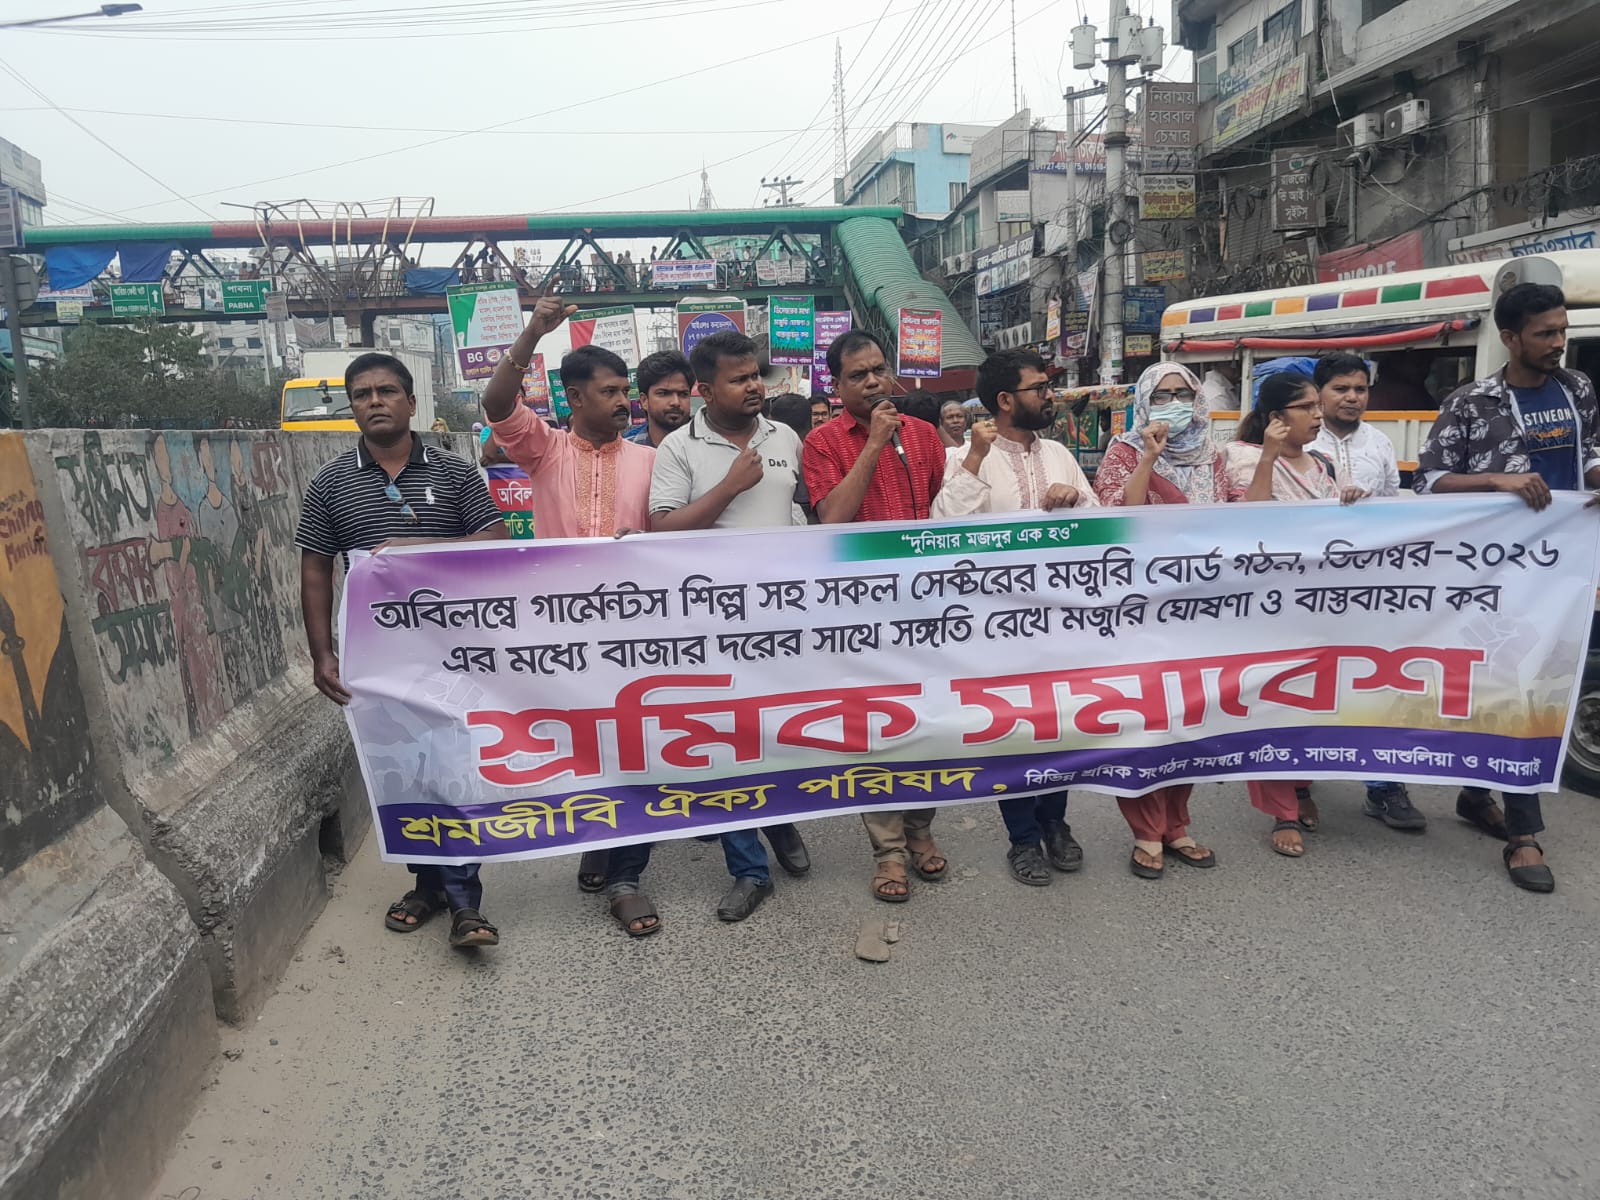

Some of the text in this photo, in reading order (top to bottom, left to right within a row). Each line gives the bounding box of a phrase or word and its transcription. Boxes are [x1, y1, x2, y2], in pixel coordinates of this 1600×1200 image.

[1150, 86, 1195, 104] নিরাময়
[1149, 111, 1195, 124] হারবাল
[226, 285, 252, 294] পাবনা
[228, 301, 254, 309] PABNA
[466, 352, 484, 363] BG
[901, 523, 1079, 554] “দুনিয়ার মজদুর এক হও”
[371, 588, 518, 630] অবিলম্বে
[531, 582, 668, 623] গার্মেন্টস
[679, 574, 747, 621] শিল্প
[757, 578, 806, 612] সহ
[815, 573, 900, 606] সকল
[910, 560, 1037, 596] সেক্টরের
[1045, 547, 1135, 597] মজুরি
[1146, 546, 1223, 591] বোর্ড
[442, 585, 1502, 675] এর মধ্যে বাজার দরের সাথে সঙ্গতি রেখে মজুরি ঘোষণা ও বাস্তবায়ন কর
[465, 645, 1488, 787] শ্রমিক সমাবেশ
[398, 793, 625, 848] শ্রমজীবি
[644, 783, 777, 818] ঐক্য
[1024, 768, 1075, 787] বিভিন্ন
[1138, 758, 1190, 780] সংগঠন
[1192, 751, 1245, 769] সমন্বয়ে
[1372, 745, 1455, 768] আশুলিয়া
[1462, 755, 1478, 769] ও
[1487, 756, 1542, 777] ধামরাই
